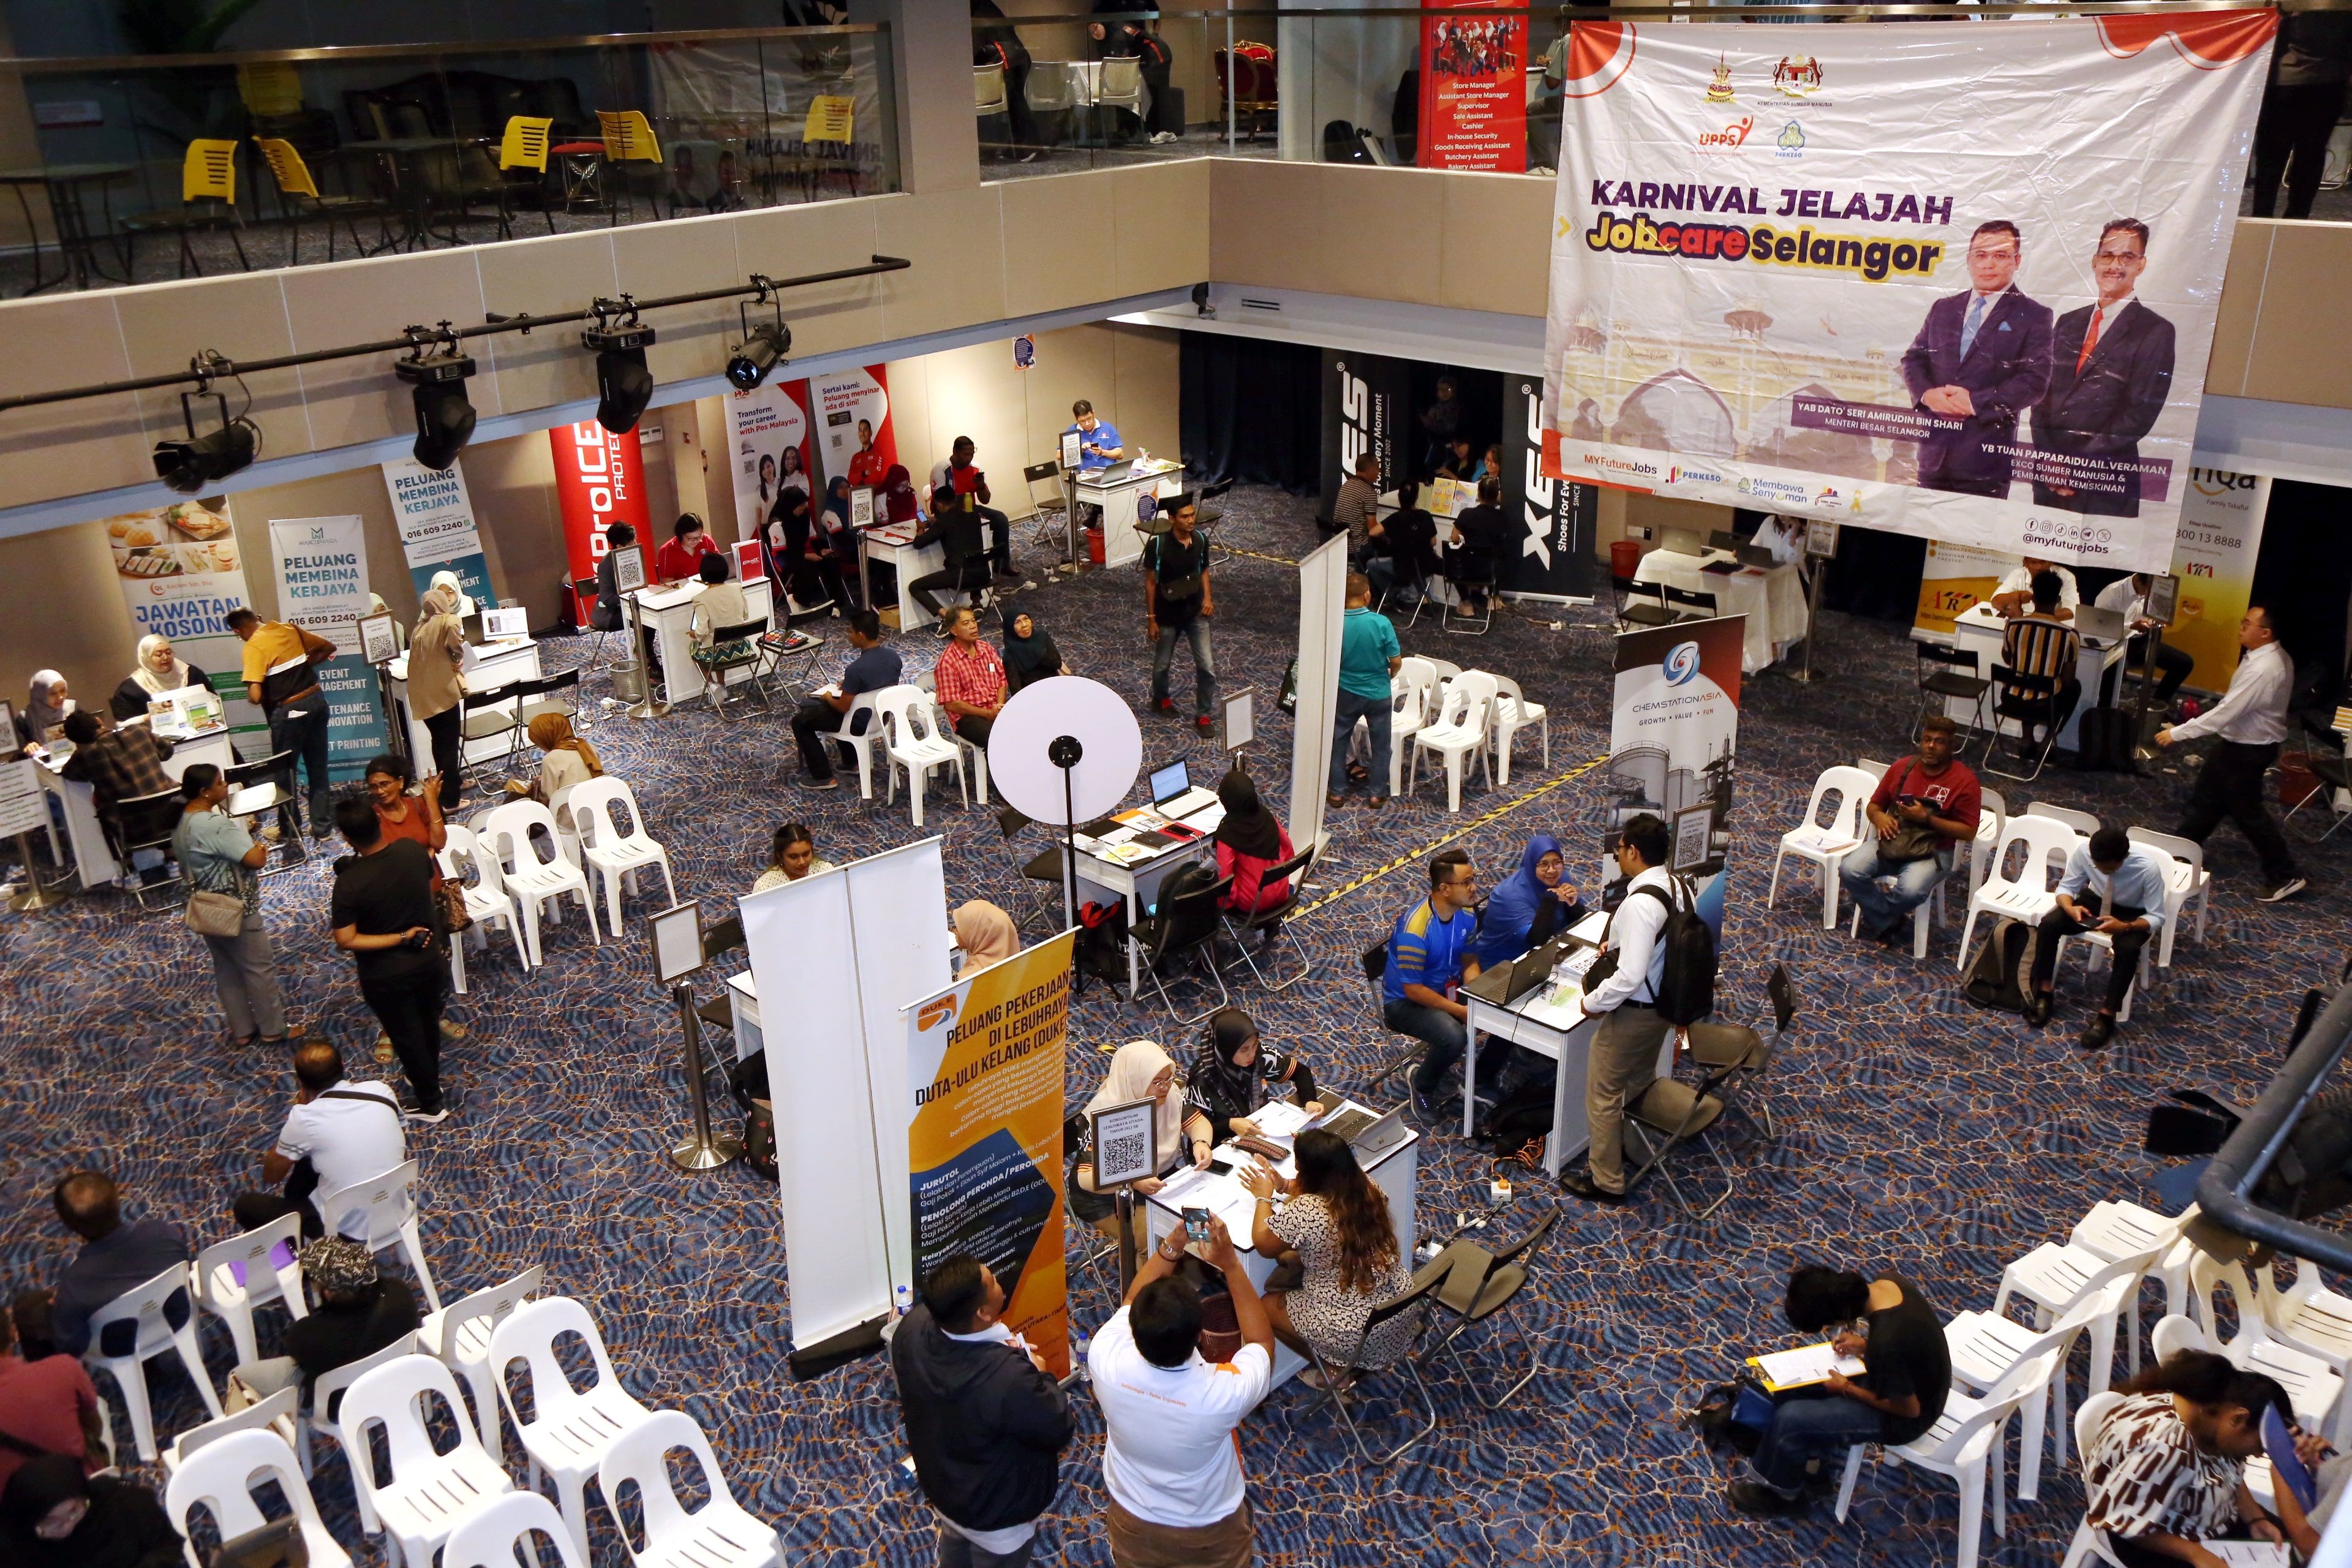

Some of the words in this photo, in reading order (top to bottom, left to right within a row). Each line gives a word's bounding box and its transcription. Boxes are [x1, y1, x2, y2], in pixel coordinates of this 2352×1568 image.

[1470, 81, 1496, 91] Manager
[1483, 91, 1509, 100] Manager
[1474, 132, 1498, 141] Security
[1699, 134, 1736, 146] UPPS
[1455, 143, 1483, 152] Receiving
[1591, 179, 1767, 214] KARNIVAL
[1776, 189, 1954, 225] JELAJAH
[822, 385, 842, 395] Sertai
[824, 392, 850, 404] Peluang
[851, 386, 880, 399] menyinar
[737, 406, 772, 419] Transform
[846, 398, 859, 407] sini!
[738, 418, 754, 428] your
[755, 413, 777, 423] career
[1374, 393, 1382, 439] Moment
[1798, 402, 1816, 412] YAB
[1817, 405, 1845, 416] DATO'
[1847, 409, 1866, 418] SERI
[1868, 411, 1914, 424] AMIRUDIN
[1916, 417, 1932, 427] BIN
[1934, 420, 1963, 431] SHARI
[739, 426, 755, 436] with
[756, 423, 769, 432] Pos
[769, 417, 799, 431] Malaysia
[1341, 371, 1368, 485] ES
[1825, 418, 1858, 429] MENTERI
[1860, 423, 1885, 432] BESAR
[1887, 426, 1930, 439] SELANGOR
[1584, 454, 1657, 475] MYFutureJobs
[1981, 443, 1995, 453] YB
[1997, 445, 2023, 457] TUAN
[2025, 449, 2088, 467] PAPPARAIDU
[395, 469, 456, 489] PELUANG
[1683, 471, 1721, 483] PERKESO
[2011, 459, 2034, 470] EXCO
[2036, 463, 2071, 476] SUMBER
[2073, 470, 2115, 481] MANUSIA
[2118, 474, 2126, 483] &
[398, 481, 459, 502] MEMBINA
[1753, 478, 1804, 494] Membawa
[2011, 470, 2067, 486] PEMBASMIAN
[2068, 478, 2125, 493] KEMISKINAN
[404, 494, 460, 514] KERJAYA
[1559, 502, 1569, 518] For
[407, 529, 422, 538] 016
[424, 526, 440, 535] 609
[441, 521, 463, 531] 2240
[1558, 519, 1567, 552] Shoes
[2176, 529, 2195, 540] 300
[2199, 532, 2211, 543] 13
[2214, 534, 2242, 549] 8888
[2023, 533, 2109, 554] @myfuturejobs
[284, 553, 357, 570] PELUANG
[285, 568, 360, 584] MEMBINA
[290, 582, 358, 598] KERJAYA
[136, 597, 241, 622] JAWATAN
[288, 616, 306, 625] 016
[308, 615, 328, 624] 609
[331, 614, 356, 623] 2240
[319, 668, 350, 680] EVENT
[320, 679, 367, 692] NAGEMENT
[330, 703, 371, 715] TENANCE
[1638, 716, 1666, 726] GROWTH
[1674, 712, 1693, 720] VALUE
[1703, 707, 1714, 716] FUN
[327, 714, 373, 727] NOVATION
[337, 737, 381, 750] PRINTING
[921, 996, 952, 1015] DUKE
[946, 1005, 1002, 1049] PELUANG
[1006, 968, 1069, 1017] PEKERJAAN
[989, 1025, 1001, 1048] DI
[1005, 991, 1068, 1041] LEBUHRAYA
[915, 1060, 978, 1106] DUTA-ULU
[981, 1036, 1031, 1074] KELANG
[968, 1072, 1001, 1093] Lebuhraya
[1002, 1063, 1020, 1075] DUKE
[954, 1085, 992, 1110] calon-calon
[992, 1076, 1010, 1090] yang
[1011, 1055, 1054, 1079] berkelayakan
[973, 1084, 1006, 1107] menyertai
[1007, 1072, 1037, 1089] keluarga
[1038, 1064, 1054, 1076] besar
[950, 1113, 985, 1137] berkarisma
[986, 1102, 1005, 1116] tinggi
[1005, 1092, 1025, 1106] boleh
[1026, 1077, 1057, 1098] memohon
[961, 1097, 1000, 1121] Calon-calon
[1000, 1088, 1018, 1101] yang
[991, 1104, 1019, 1121] mengisi
[1019, 1091, 1046, 1110] jawatan
[1103, 1121, 1128, 1130] LEBUHRAYA
[1109, 1113, 1139, 1123] KONSORTIUM
[920, 1185, 943, 1200] (Lelaki
[944, 1178, 957, 1189] dan
[957, 1153, 995, 1182] Perempuan)
[920, 1167, 960, 1191] JURUTOL
[921, 1197, 936, 1207] Gaji
[937, 1188, 955, 1202] Pokok
[960, 1174, 976, 1187] Elaun
[977, 1165, 989, 1177] Syif
[989, 1155, 1011, 1170] Malam
[1017, 1145, 1035, 1156] Kerja
[1035, 1136, 1051, 1148] Lebih
[921, 1194, 966, 1224] PENOLONG
[921, 1225, 960, 1248] Mempunyai
[960, 1212, 978, 1227] Lesen
[978, 1194, 1011, 1216] Memandu
[1031, 1175, 1049, 1190] (GDL)
[921, 1229, 937, 1240] Gaji
[937, 1221, 956, 1233] Pokok
[960, 1206, 976, 1219] Kerja
[976, 1196, 993, 1209] Lebih
[993, 1186, 1011, 1199] Masa
[921, 1219, 944, 1232] (Lelaki
[944, 1201, 967, 1222] Sahaja)
[963, 1243, 975, 1253] SPM
[975, 1235, 990, 1245] atau
[990, 1216, 1022, 1238] setarafnya
[968, 1224, 995, 1242] Malaysia
[979, 1248, 990, 1259] hari
[990, 1237, 1013, 1251] minggu
[1019, 1226, 1031, 1235] cuti
[1031, 1217, 1052, 1229] umum
[921, 1238, 960, 1262] Kelayakan:
[976, 1238, 997, 1253] keatas
